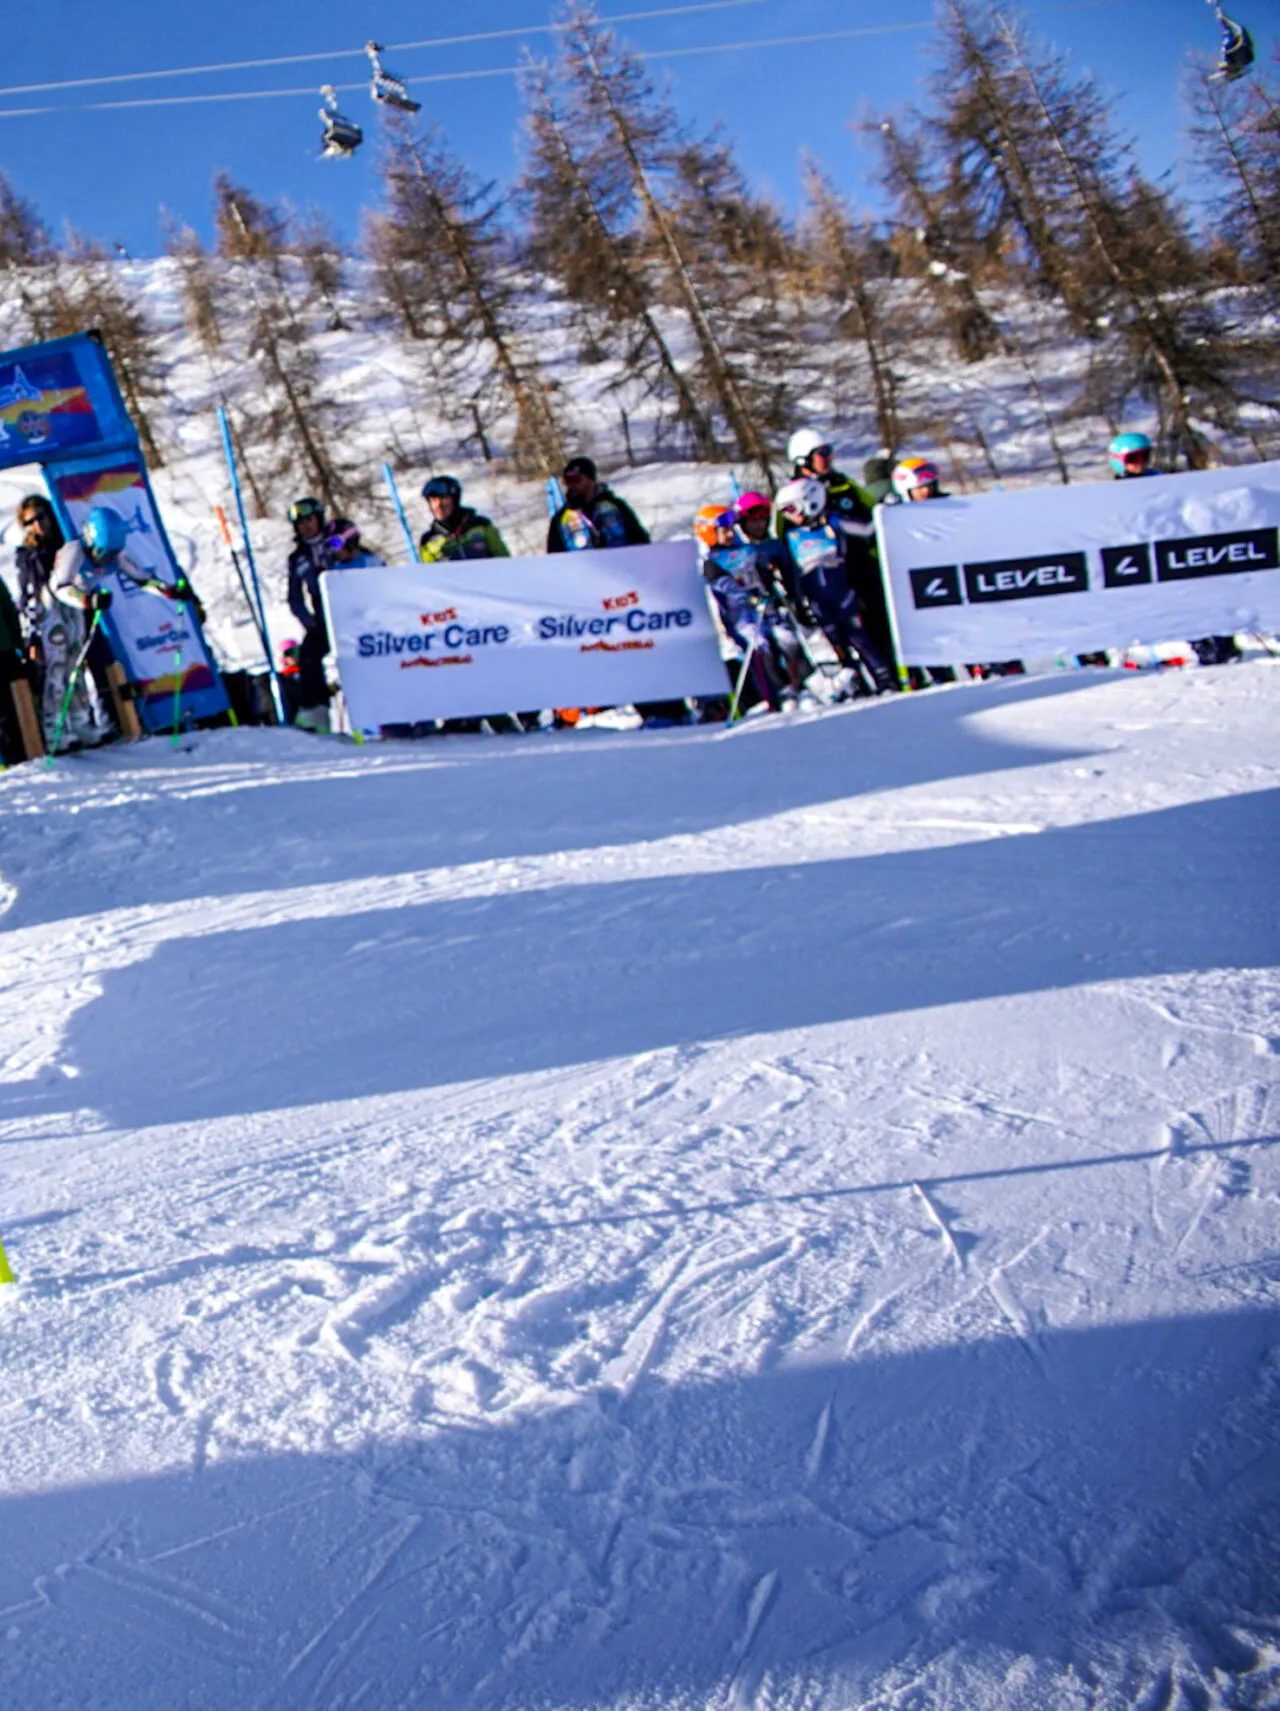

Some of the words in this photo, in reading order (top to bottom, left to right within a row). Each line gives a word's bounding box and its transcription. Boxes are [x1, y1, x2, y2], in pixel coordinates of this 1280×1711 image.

[1167, 541, 1267, 569] LEVEL
[977, 564, 1076, 593] LEVEL
[539, 613, 619, 639] Silver
[626, 609, 692, 632] Care
[357, 630, 436, 658] Silver
[444, 624, 510, 649] Care
